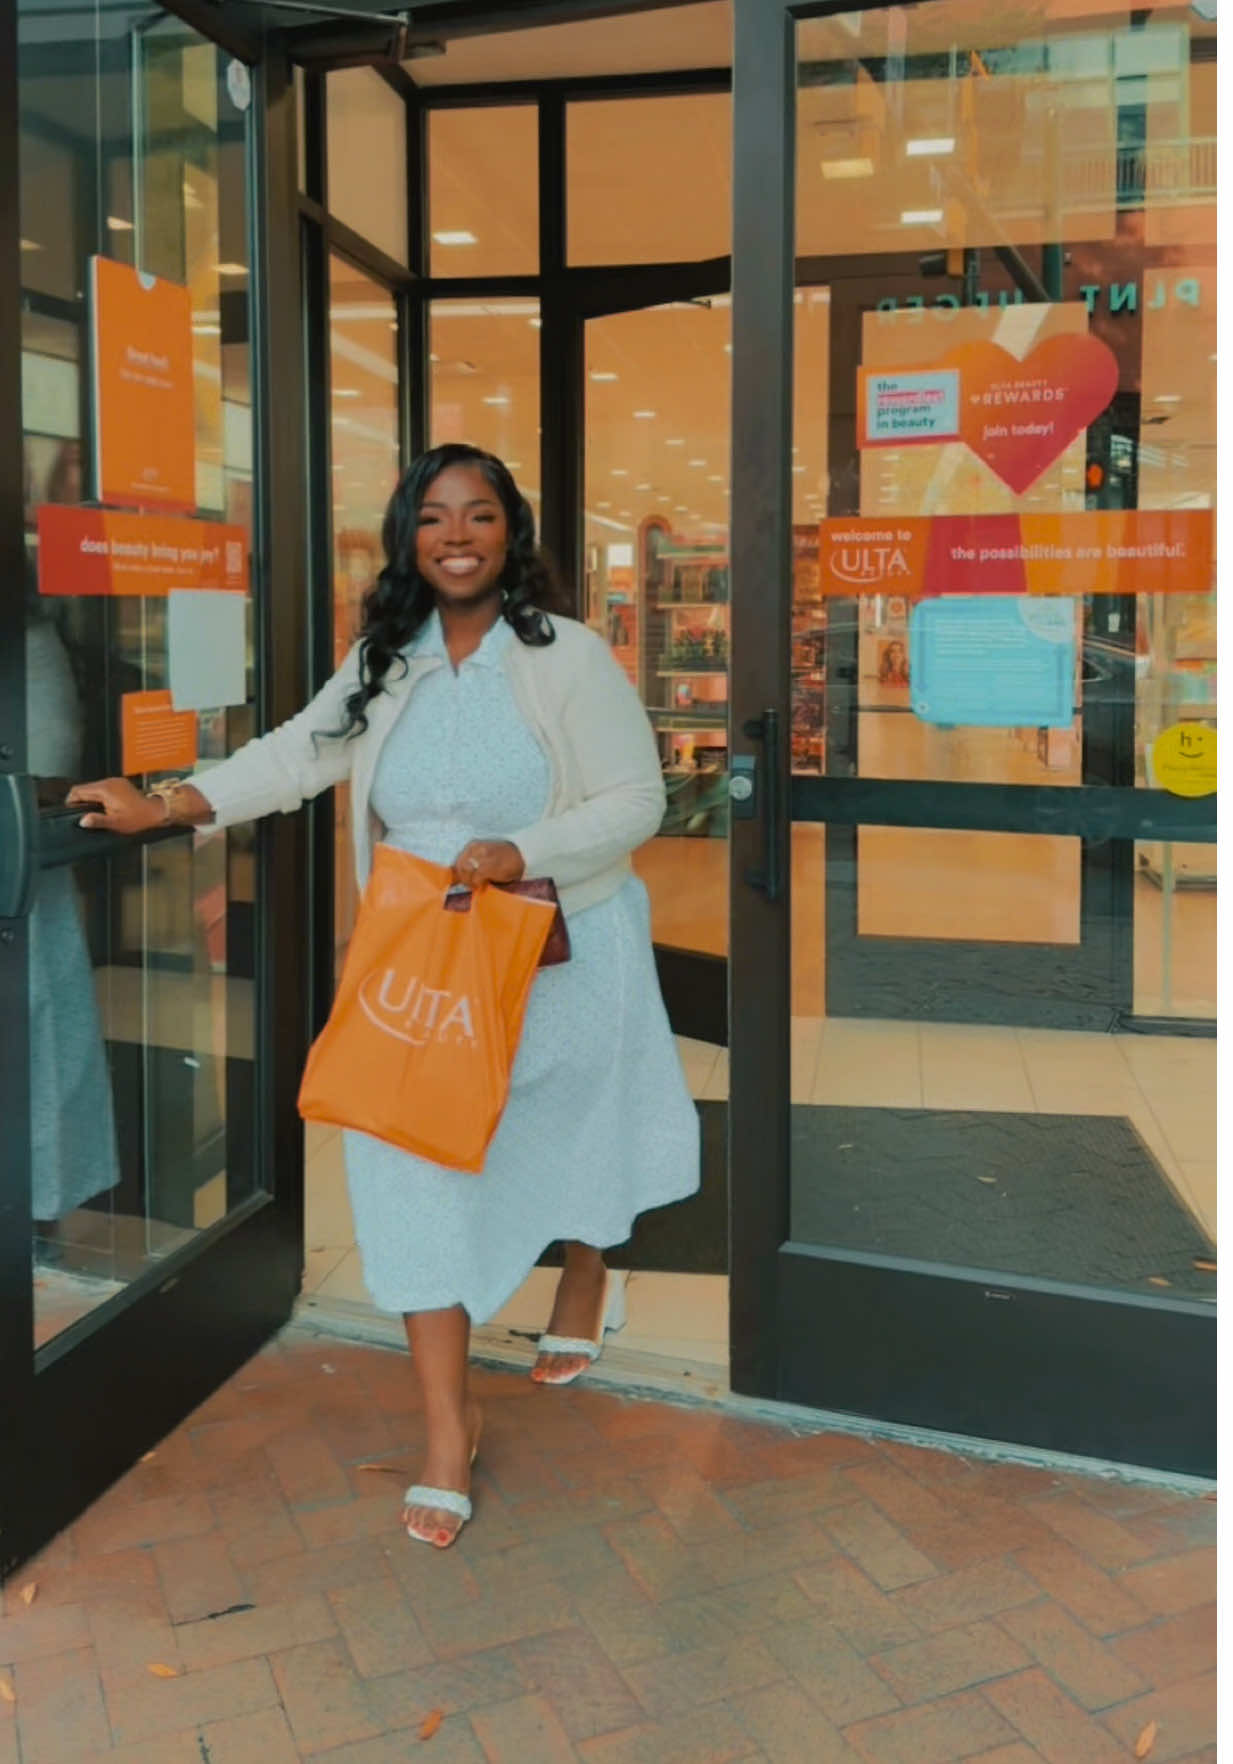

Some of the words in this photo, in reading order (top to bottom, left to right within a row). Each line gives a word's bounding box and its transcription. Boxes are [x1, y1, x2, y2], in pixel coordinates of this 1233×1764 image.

[877, 380, 898, 392] the
[983, 387, 1065, 404] REWARDS
[876, 404, 931, 417] program
[891, 417, 936, 431] beauty
[831, 529, 893, 543] welcome
[896, 529, 912, 543] to
[951, 545, 975, 560] the
[979, 543, 1072, 564] possibilities
[1076, 548, 1102, 560] are
[836, 547, 911, 577] ULTA
